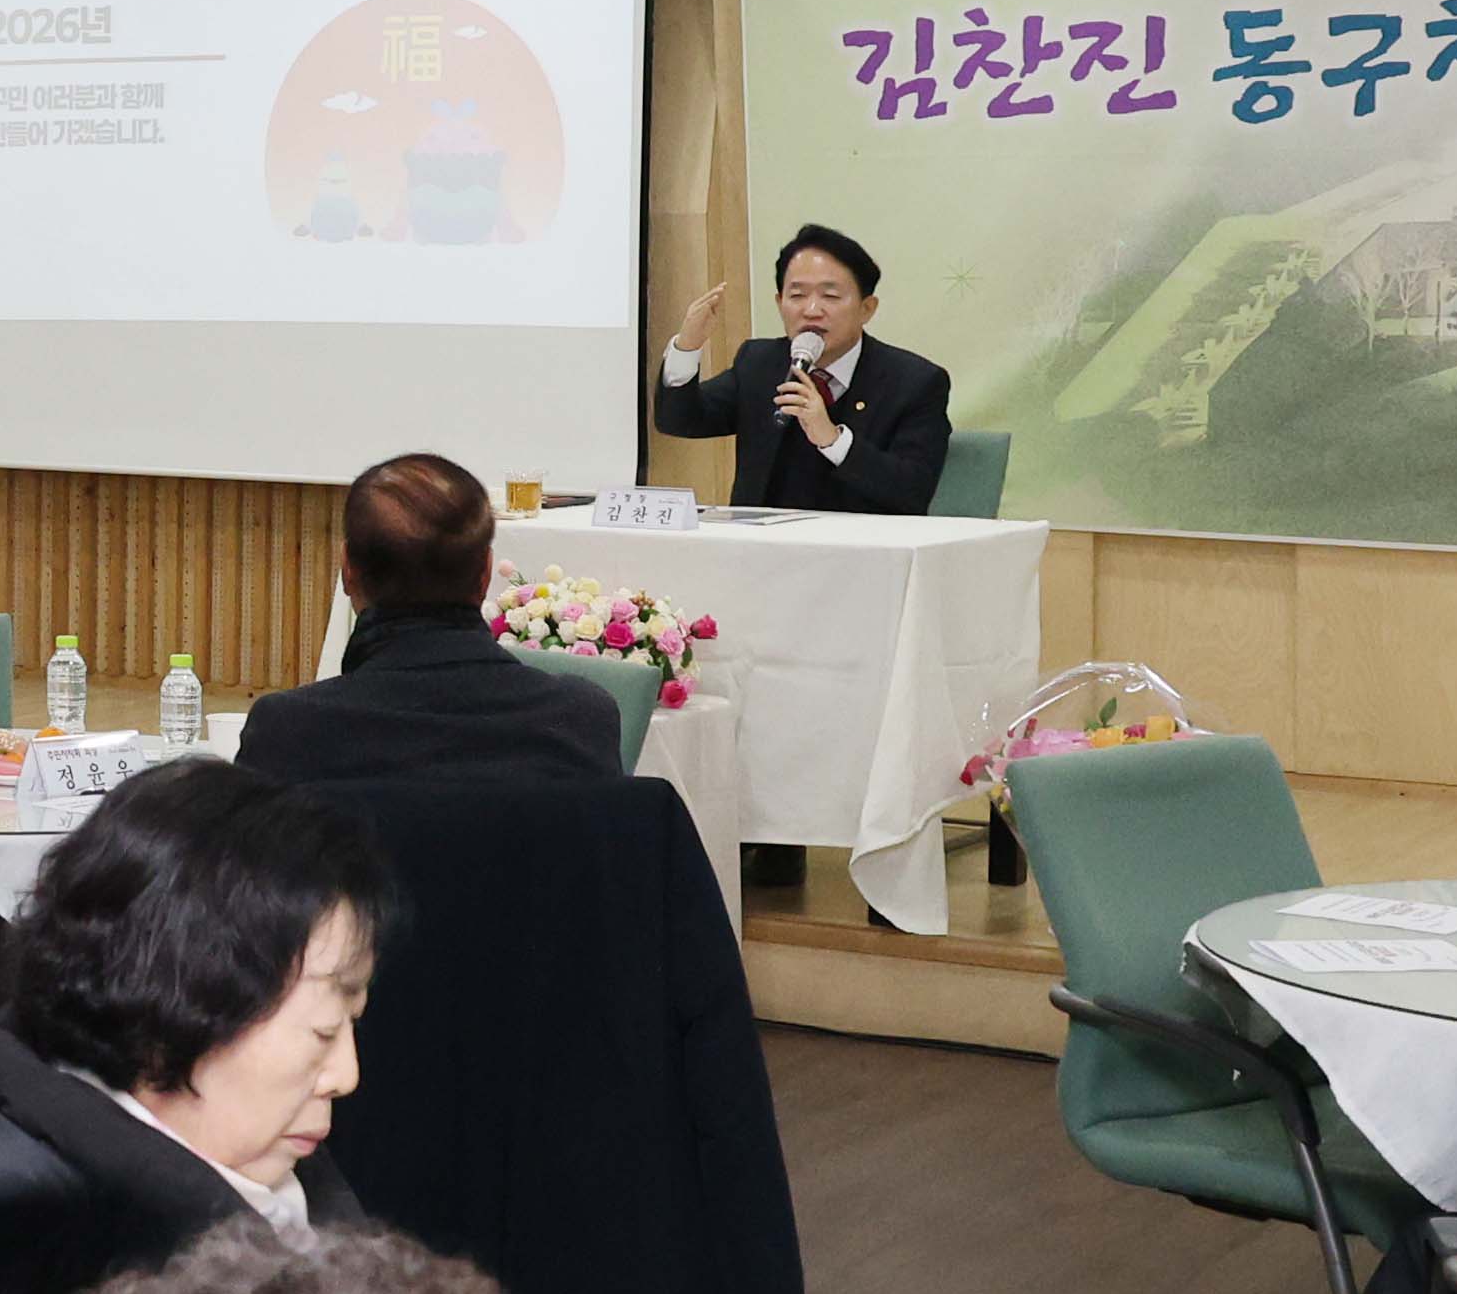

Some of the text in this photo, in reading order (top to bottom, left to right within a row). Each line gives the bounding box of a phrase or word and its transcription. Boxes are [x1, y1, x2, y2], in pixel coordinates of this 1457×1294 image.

[380, 15, 444, 83] 福
[842, 8, 1178, 120] 김찬진
[33, 84, 118, 111] 여러분과
[120, 82, 166, 110] 함께
[51, 118, 166, 146] 가겠습니다.
[606, 504, 673, 525] 김찬진
[56, 759, 134, 791] 정윤우
